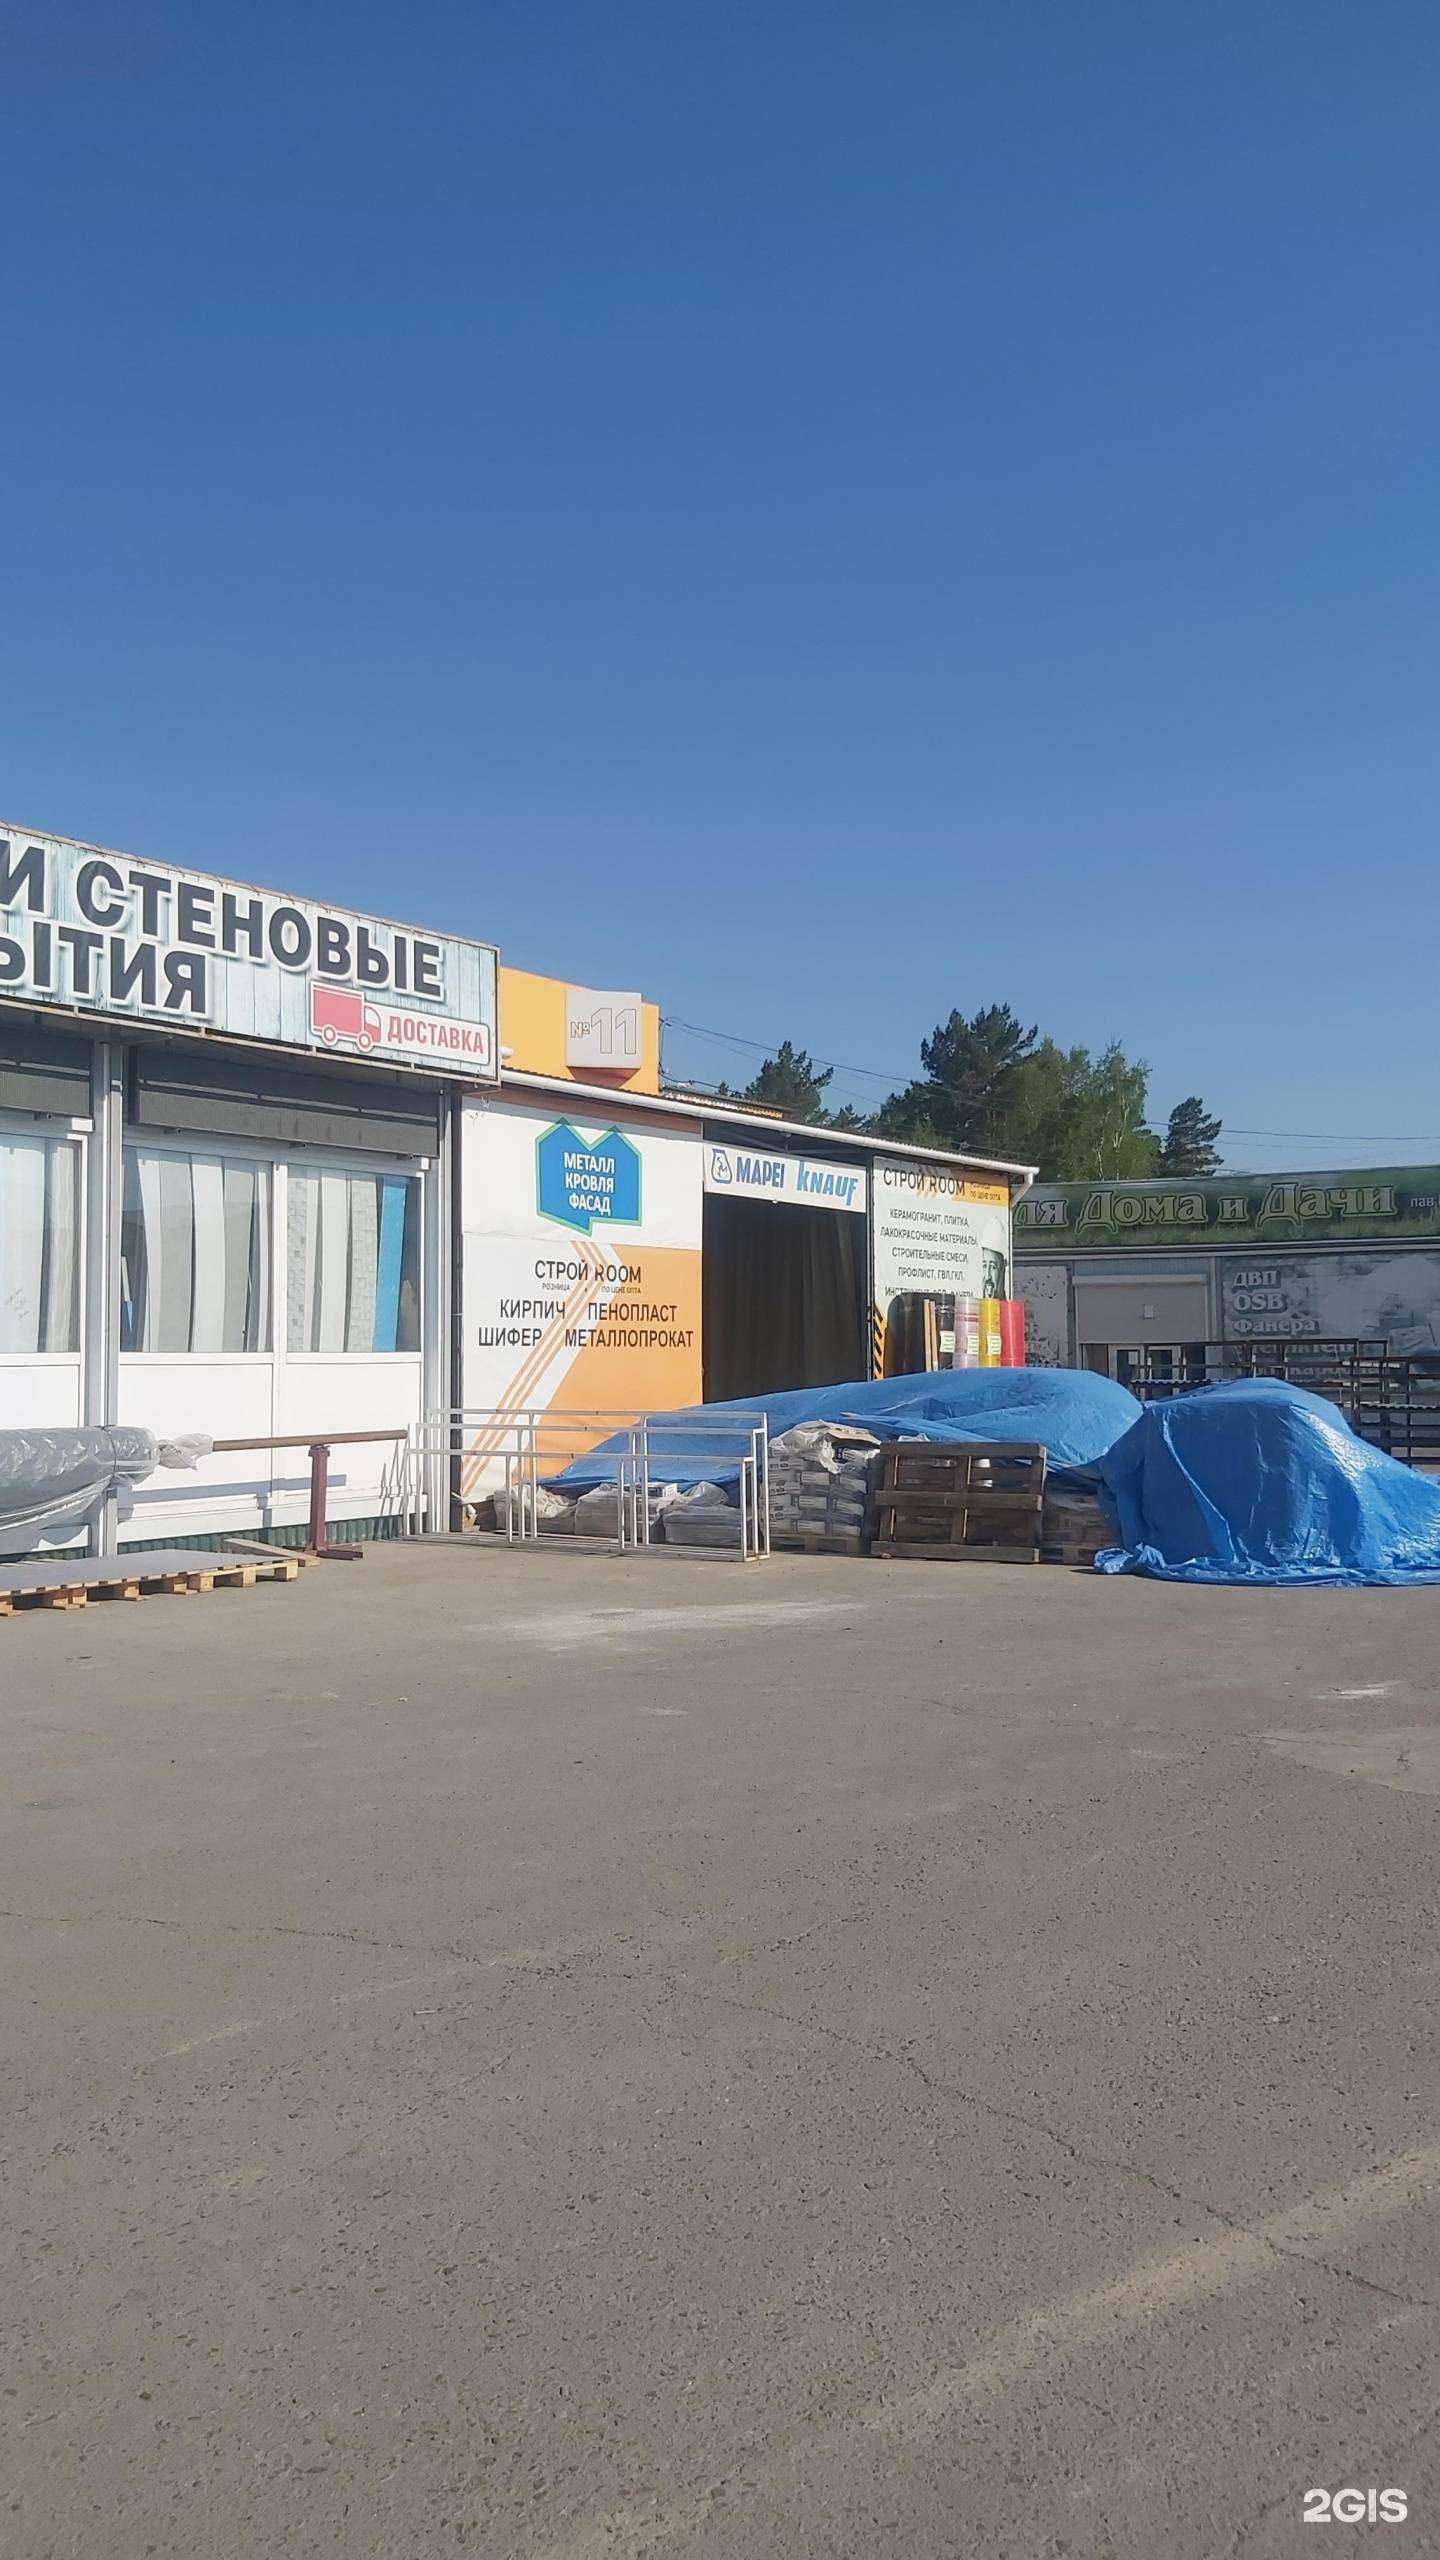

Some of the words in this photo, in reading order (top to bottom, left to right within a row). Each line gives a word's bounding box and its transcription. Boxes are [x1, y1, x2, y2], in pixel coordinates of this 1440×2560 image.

[76, 860, 442, 998] СТЕНОВЫЕ
[387, 1015, 484, 1055] ДОСТАВКА
[563, 1151, 615, 1174] МЕТАЛЛ
[735, 1156, 786, 1189] MAPEI
[565, 1172, 615, 1194] КРОВЛЯ
[883, 1167, 925, 1192] СТРОЙ
[929, 1175, 966, 1197] ROOM
[568, 1192, 611, 1217] ФАСАД
[1012, 1200, 1069, 1228] ля
[1076, 1190, 1208, 1234] Дома
[1218, 1197, 1249, 1223] и
[1257, 1182, 1396, 1229] Дачи
[880, 1226, 938, 1242] ЛАКОКРАСОЧНЫЕ
[892, 1246, 945, 1261] СТРОИТЕЛЬНЫЕ
[534, 1258, 588, 1281] СТРОЙ
[594, 1264, 642, 1283] ROOM
[1232, 1270, 1279, 1289] ДВП
[499, 1299, 566, 1320] КИРПИЧ
[587, 1302, 678, 1322] ПЕНОПЛАСТ
[1232, 1293, 1285, 1312] OSB
[478, 1327, 542, 1347] ШИФЕР
[564, 1328, 694, 1348] МЕТАЛЛОПРОКАТ
[1232, 1319, 1317, 1336] Фанера
